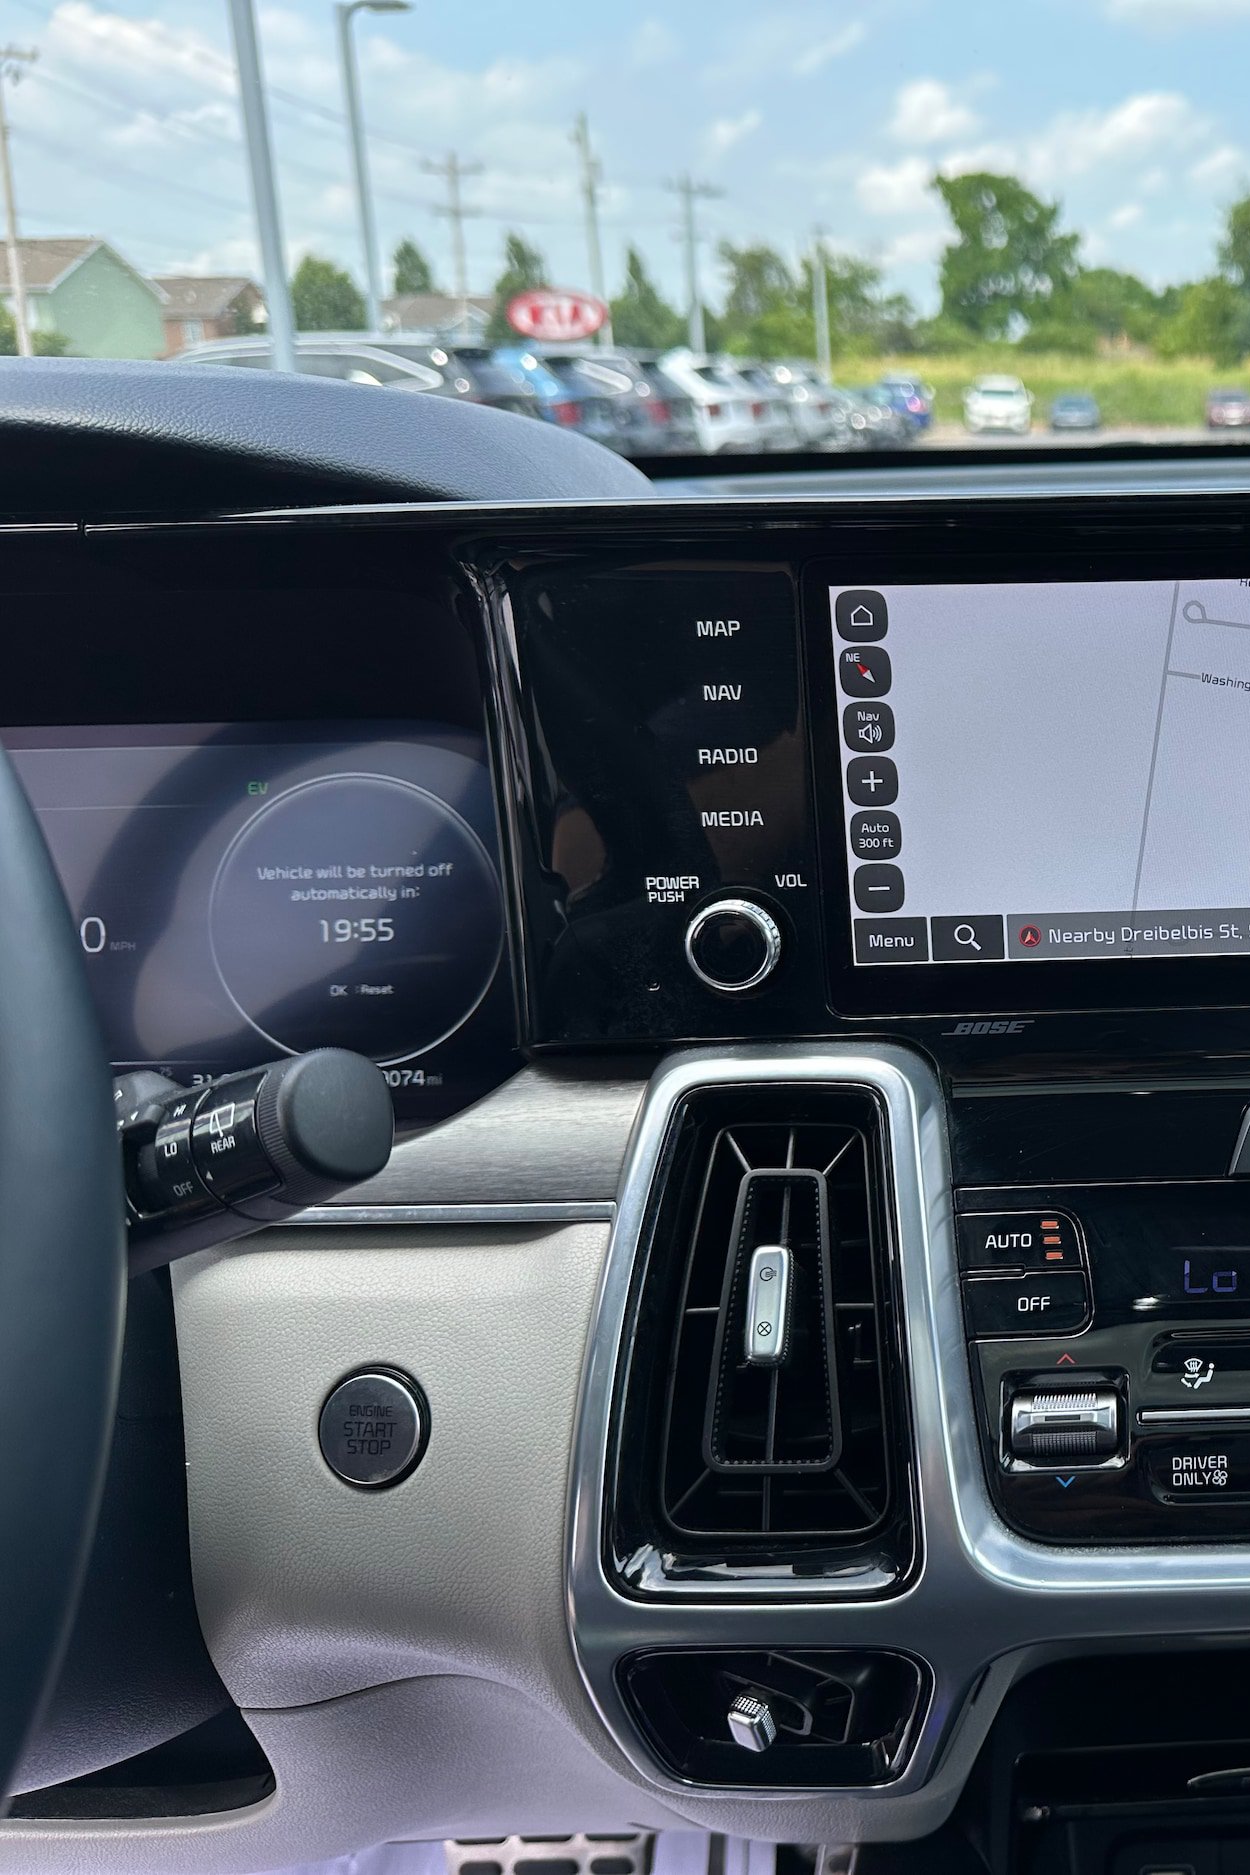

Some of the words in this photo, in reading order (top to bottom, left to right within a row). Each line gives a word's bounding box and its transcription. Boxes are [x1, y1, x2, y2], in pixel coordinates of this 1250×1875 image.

[697, 620, 741, 637] MAP
[845, 652, 861, 662] NE
[703, 684, 742, 701] NAV
[857, 711, 880, 722] Nav
[698, 748, 759, 765] RADIO
[247, 782, 269, 795] EV
[701, 810, 764, 827] MEDIA
[861, 822, 890, 833] Auto
[859, 837, 881, 849] 300
[882, 837, 894, 848] ft
[256, 865, 313, 881] Vehicle
[315, 865, 343, 879] will
[347, 864, 366, 879] be
[370, 863, 425, 878] turned
[428, 862, 453, 877] off
[646, 875, 700, 890] POWER
[774, 874, 808, 888] VOL
[290, 885, 398, 902] automatically
[648, 891, 685, 903] PUSH
[80, 916, 107, 953] 0
[109, 941, 137, 951] MPH
[318, 917, 395, 943] 19:55
[1049, 928, 1115, 945] Nearby
[1121, 924, 1214, 942] Dreibelbis
[1218, 924, 1243, 941] St,
[869, 933, 915, 948] Menu
[329, 984, 348, 997] OK
[941, 1019, 1035, 1036] BOSE
[173, 1104, 187, 1117] HI
[164, 1142, 178, 1158] LO
[210, 1135, 236, 1154] REAR
[173, 1181, 194, 1197] OFF
[985, 1233, 1032, 1249] AUTO
[1184, 1259, 1238, 1294] Lo
[1017, 1296, 1051, 1312] OFF
[348, 1404, 394, 1418] ENGINE
[343, 1421, 398, 1438] START
[346, 1439, 392, 1455] STOP
[1172, 1454, 1228, 1471] DRIVER
[1172, 1471, 1212, 1487] ONLY
